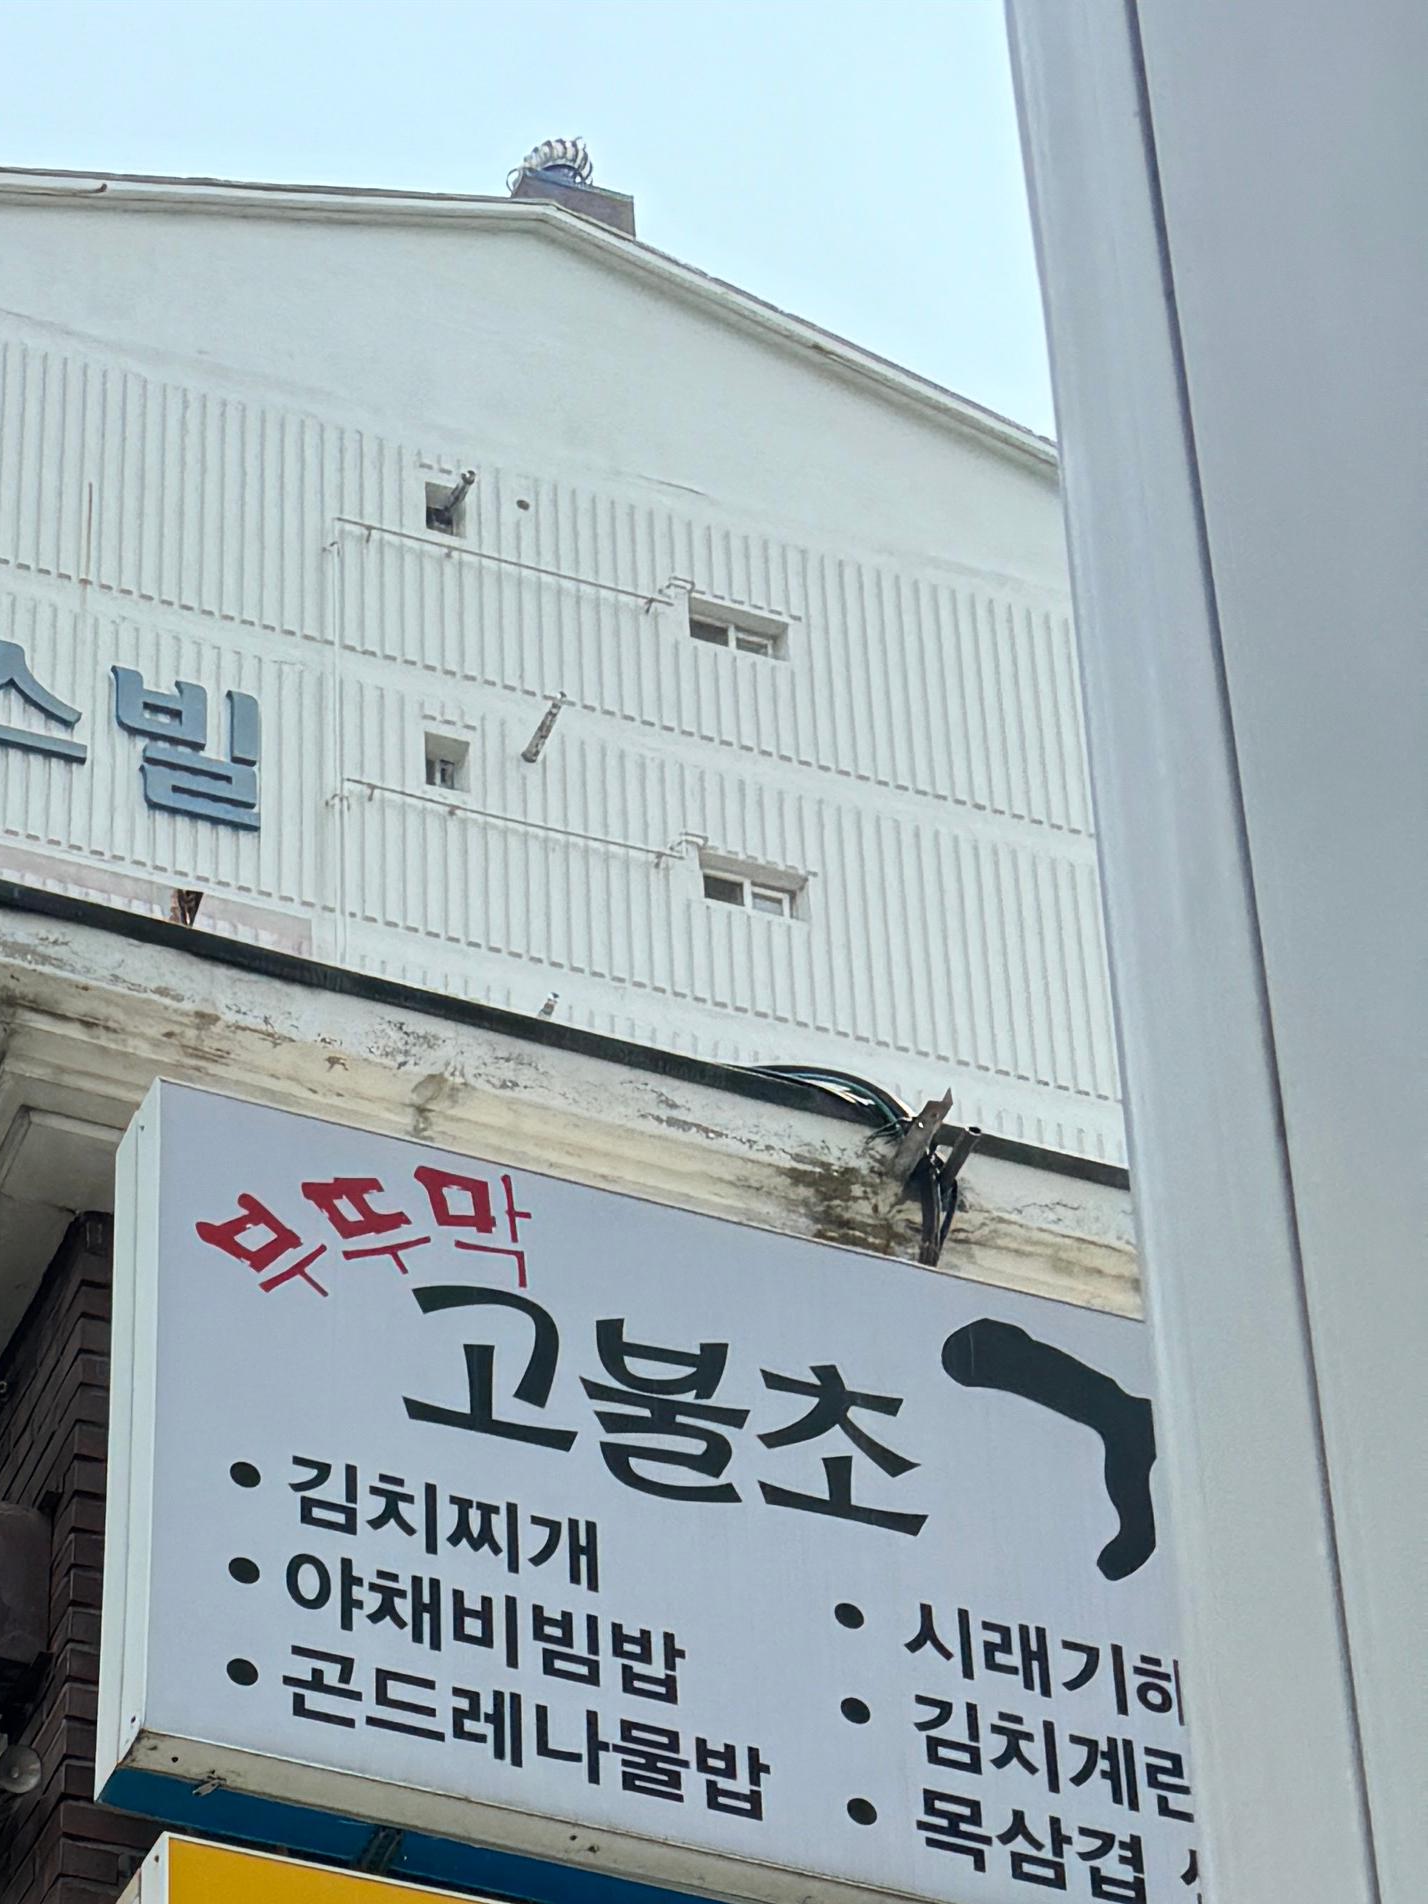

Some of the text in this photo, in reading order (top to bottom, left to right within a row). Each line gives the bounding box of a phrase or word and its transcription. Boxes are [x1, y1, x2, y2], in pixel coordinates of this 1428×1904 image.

[196, 1165, 532, 1297] 부뚜막
[401, 1284, 929, 1536] 고불초
[286, 1453, 600, 1592] 김치찌개
[285, 1551, 687, 1704] 야채비빔밥
[281, 1643, 771, 1822] 곤드레나물밥
